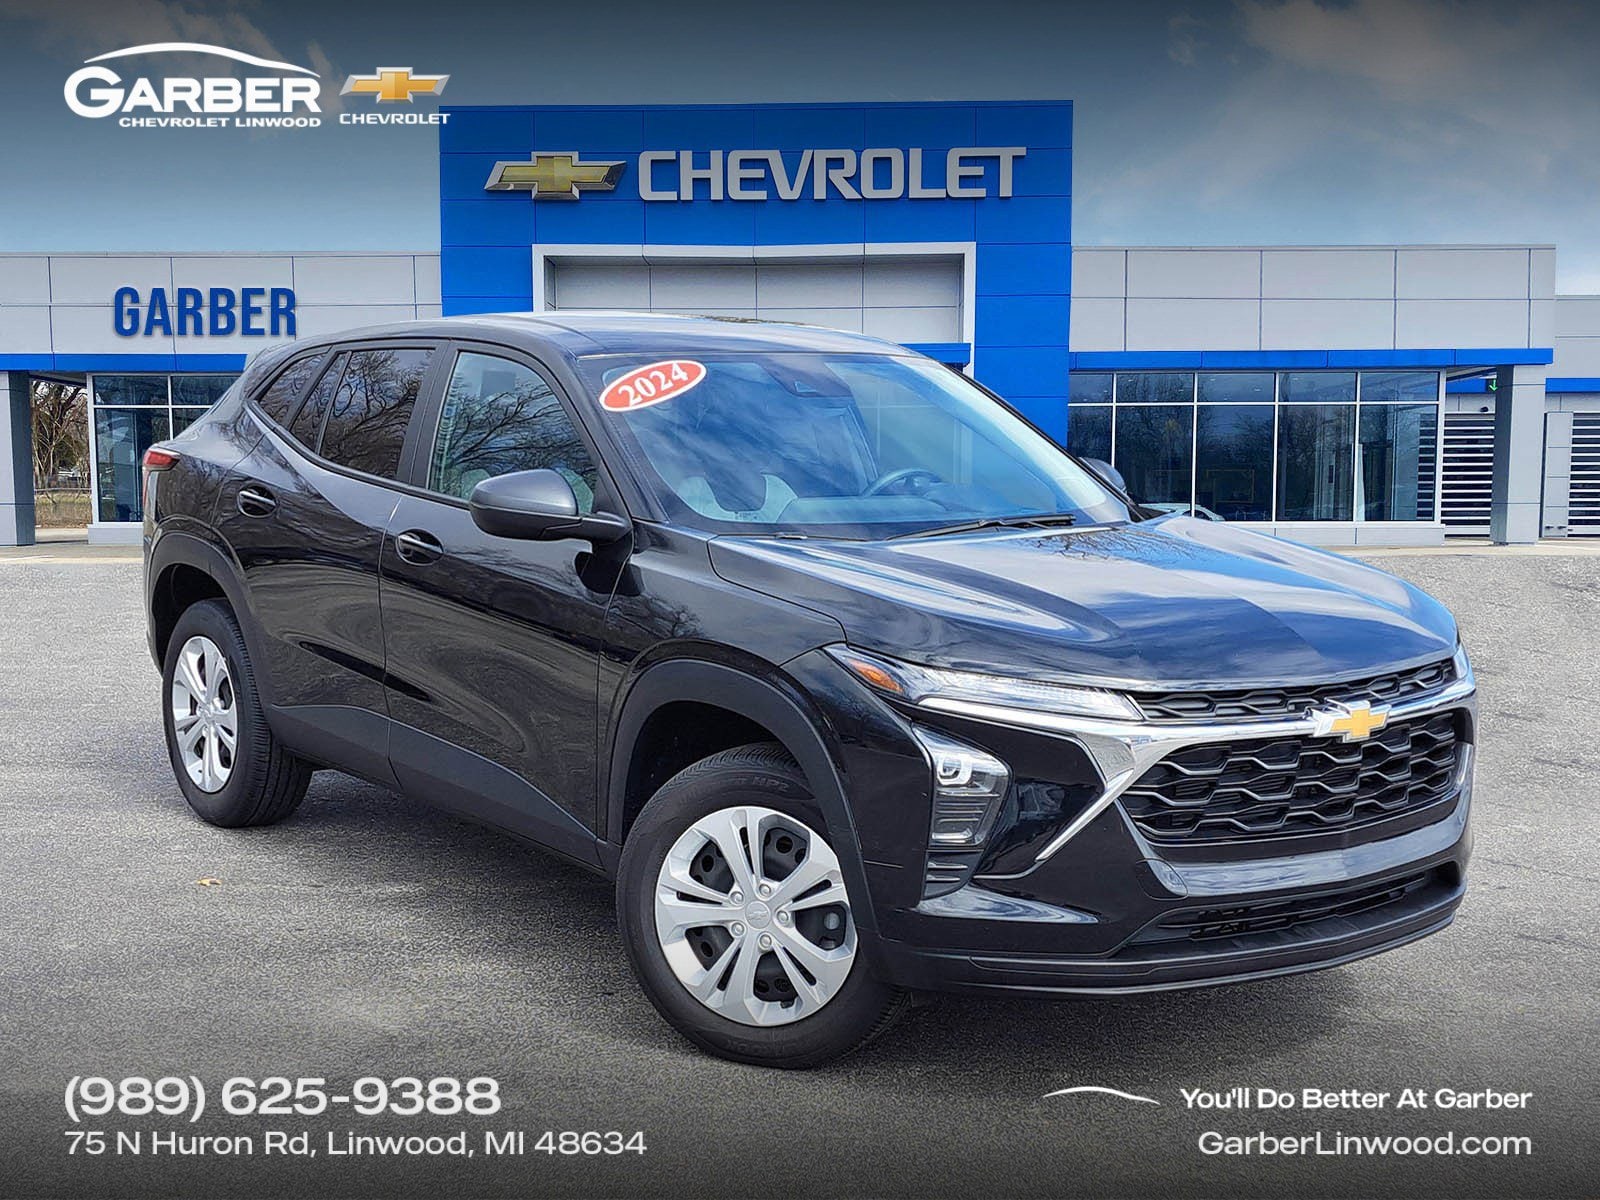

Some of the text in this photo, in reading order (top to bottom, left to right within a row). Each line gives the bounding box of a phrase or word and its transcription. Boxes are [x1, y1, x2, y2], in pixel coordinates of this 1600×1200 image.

[638, 147, 1027, 201] CHEVROLET
[113, 286, 297, 337] GARBER
[617, 362, 689, 406] 2024
